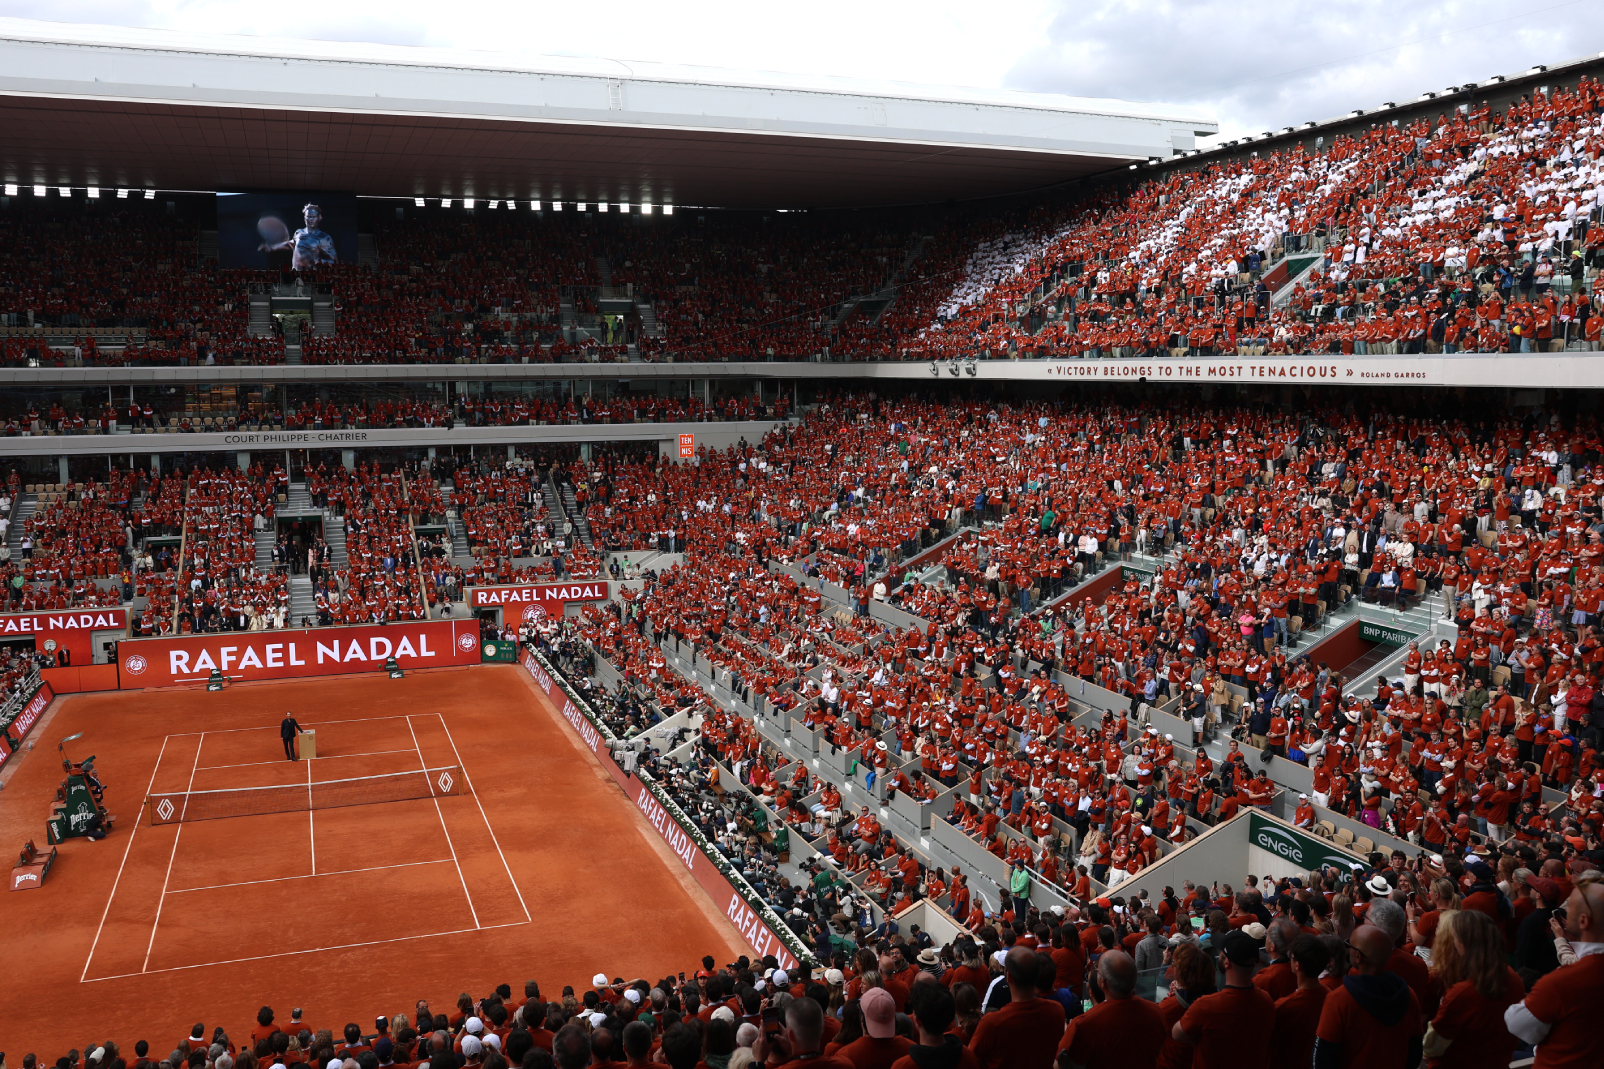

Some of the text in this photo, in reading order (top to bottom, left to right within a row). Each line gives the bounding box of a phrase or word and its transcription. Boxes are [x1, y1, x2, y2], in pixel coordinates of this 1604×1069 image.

[1056, 366, 1098, 376] VICTORY
[1103, 366, 1152, 376] BELONGS
[1158, 366, 1172, 376] TO
[1178, 366, 1201, 376] THE
[1207, 366, 1243, 377] MOST
[1250, 366, 1337, 377] TENACIOUS
[225, 434, 260, 444] COURT
[263, 433, 309, 443] PHILIPPE
[318, 432, 367, 442] CHATRIER
[477, 585, 603, 604] RAFAEL NADAL
[49, 613, 119, 630] NADAL
[1363, 626, 1412, 644] BNP PARIBA
[169, 642, 306, 675] RAFAEL
[316, 634, 436, 664] NADAL
[525, 654, 553, 695] RAFAEL NADAL
[15, 693, 47, 735] RAFAEL NADAL
[563, 699, 600, 753] RAFAEL NADAL
[637, 787, 697, 870] RAFAEL NADAL
[727, 893, 773, 958] RAFAEL
